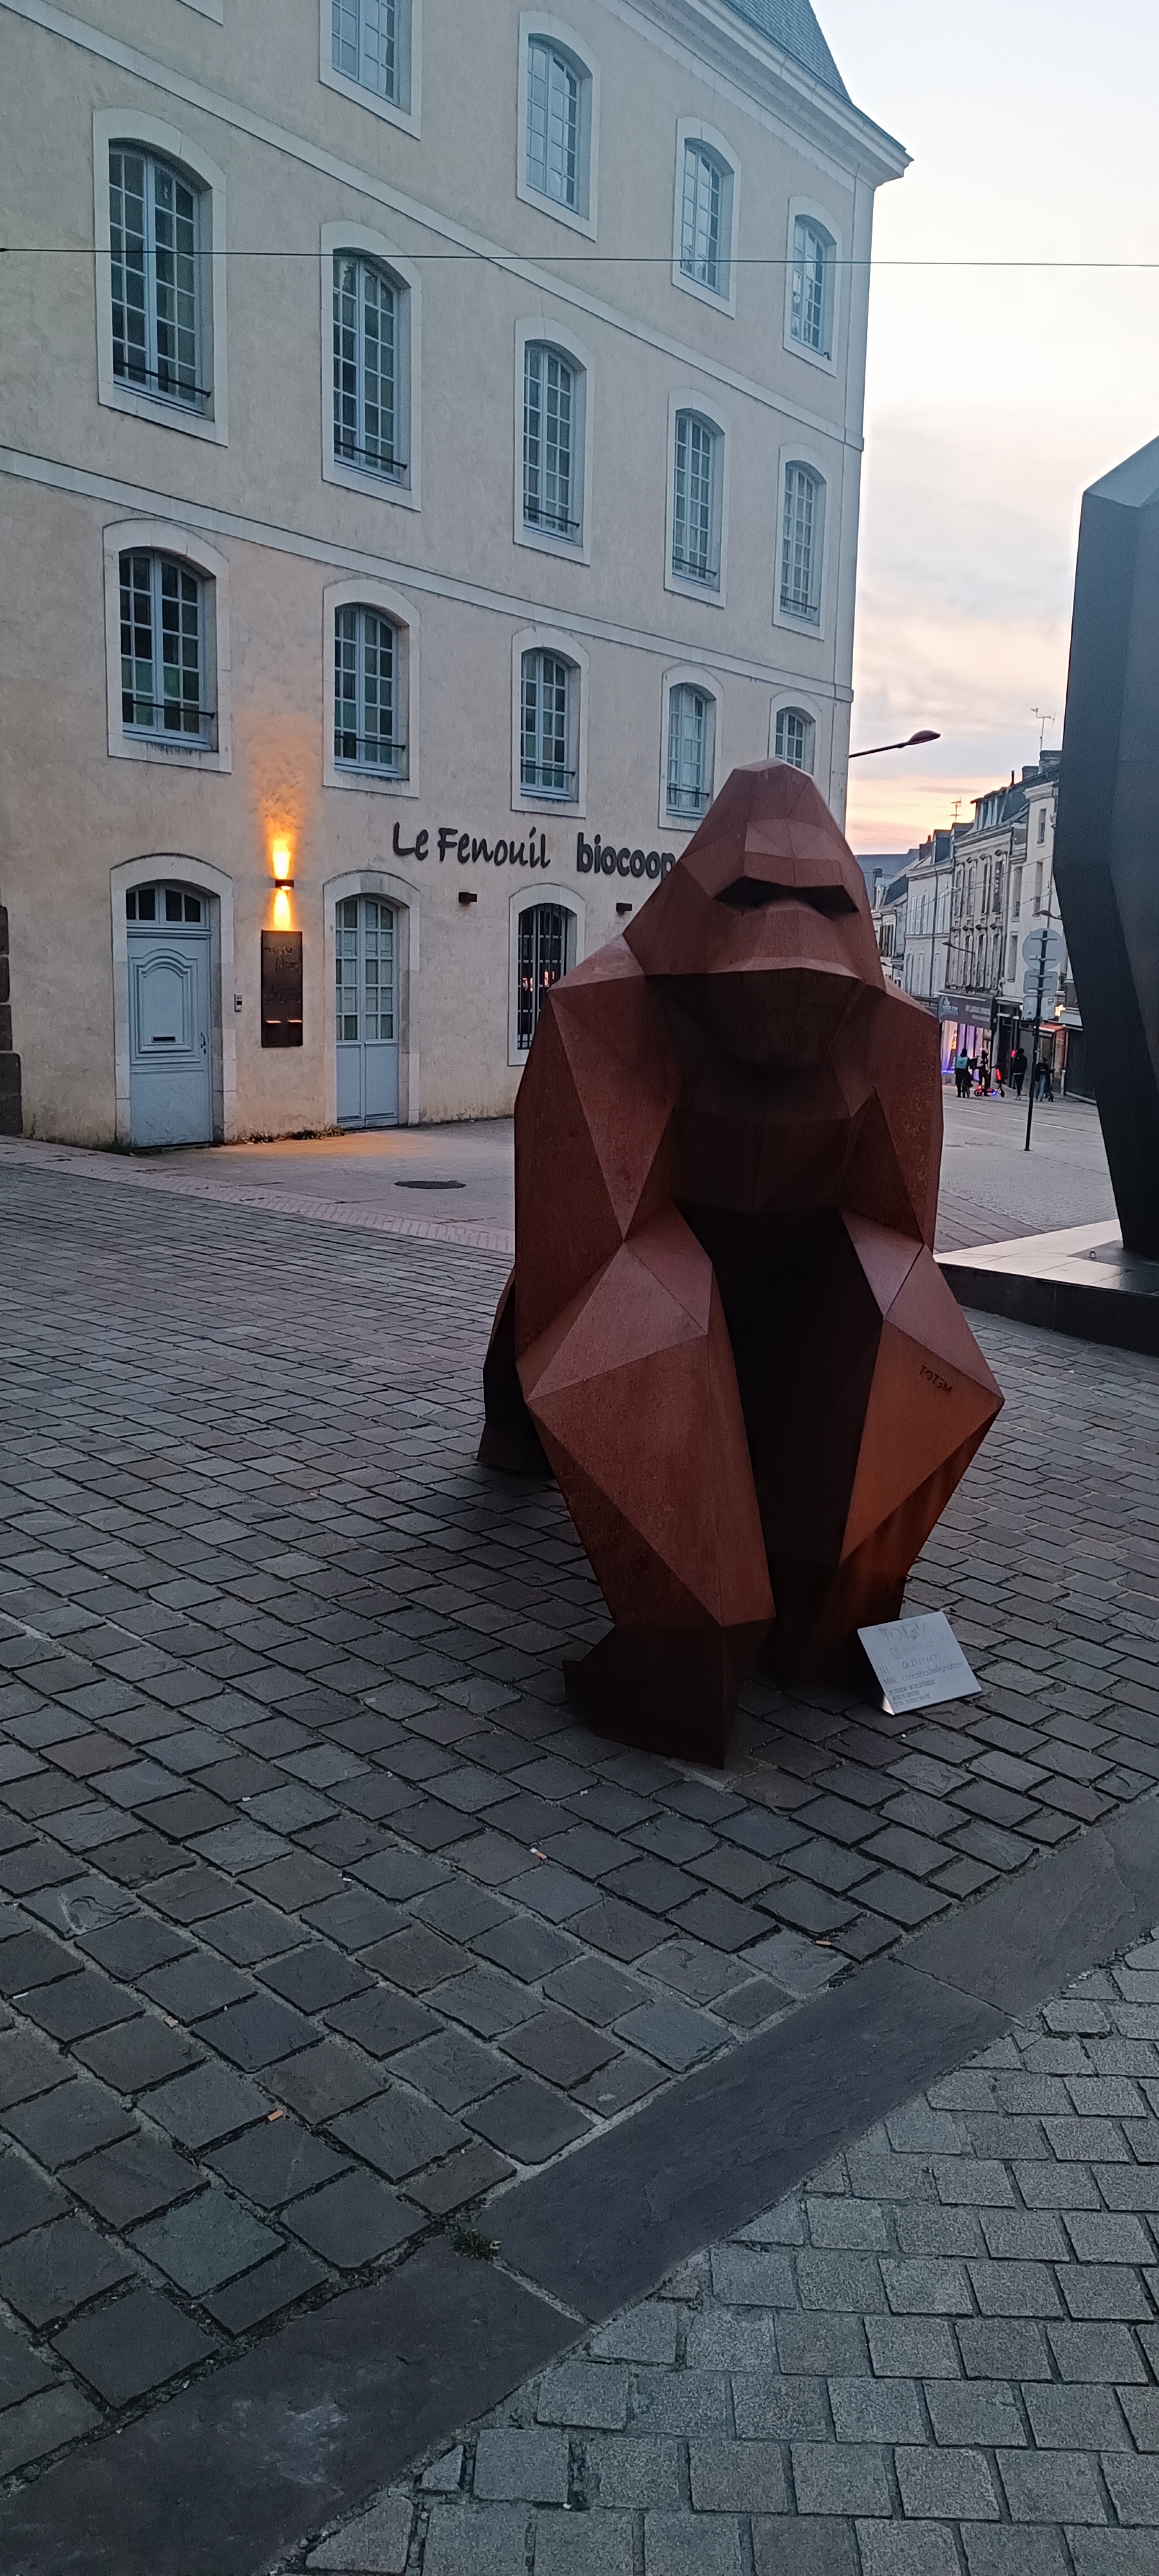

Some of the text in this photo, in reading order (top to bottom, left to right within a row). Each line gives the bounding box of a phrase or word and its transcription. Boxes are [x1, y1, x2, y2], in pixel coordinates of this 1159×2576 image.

[391, 822, 551, 869] Le Fenouil
[576, 831, 676, 882] biocoop
